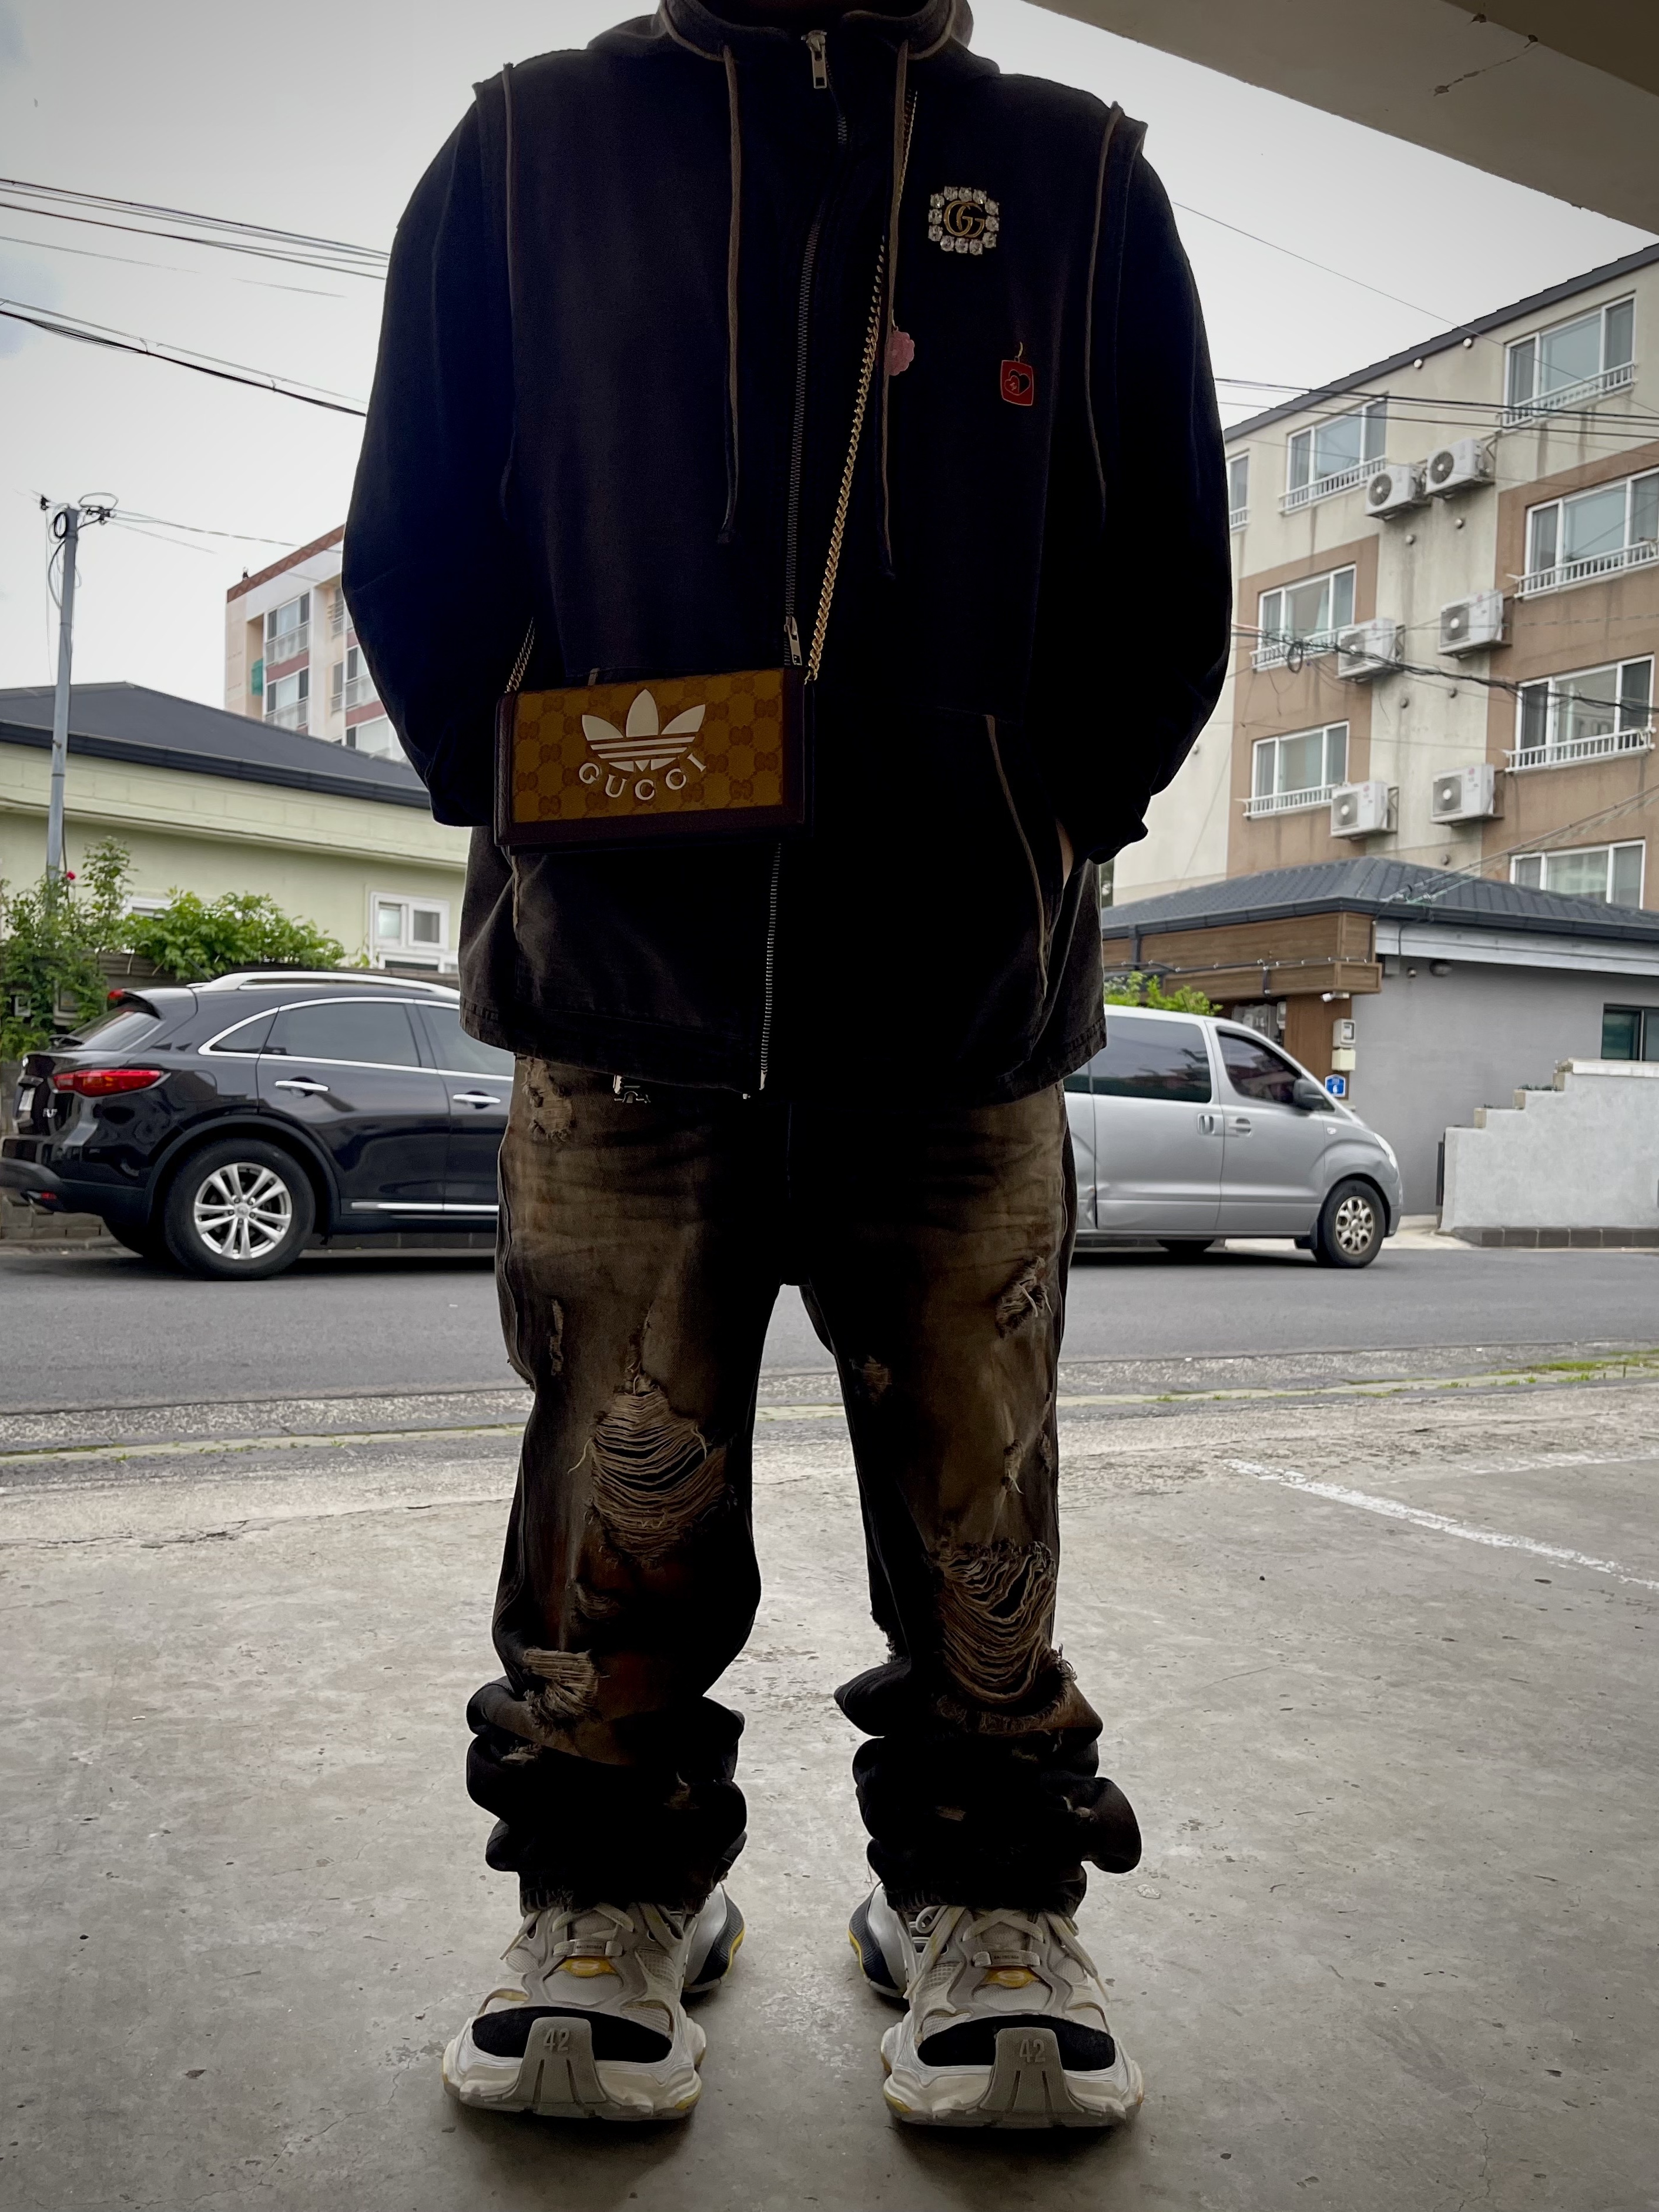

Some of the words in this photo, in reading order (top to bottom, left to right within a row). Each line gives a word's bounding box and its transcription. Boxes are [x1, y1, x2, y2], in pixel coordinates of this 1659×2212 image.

[579, 753, 706, 800] GUCCI
[543, 2028, 570, 2051] 42
[1020, 2039, 1045, 2062] 42
